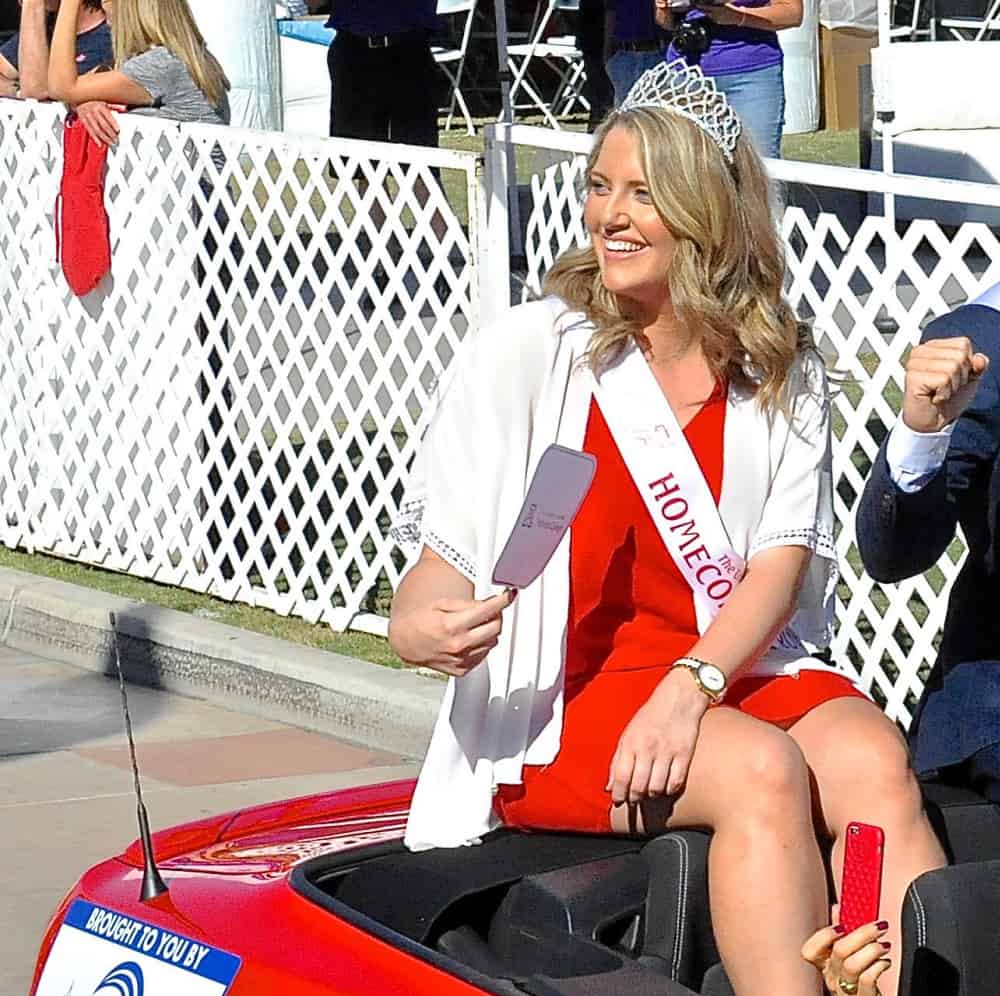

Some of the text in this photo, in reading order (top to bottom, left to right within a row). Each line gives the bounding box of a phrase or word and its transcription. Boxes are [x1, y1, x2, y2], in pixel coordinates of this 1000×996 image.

[648, 472, 732, 608] HOMECO
[85, 907, 210, 970] BROUGHT TO YOU BY
